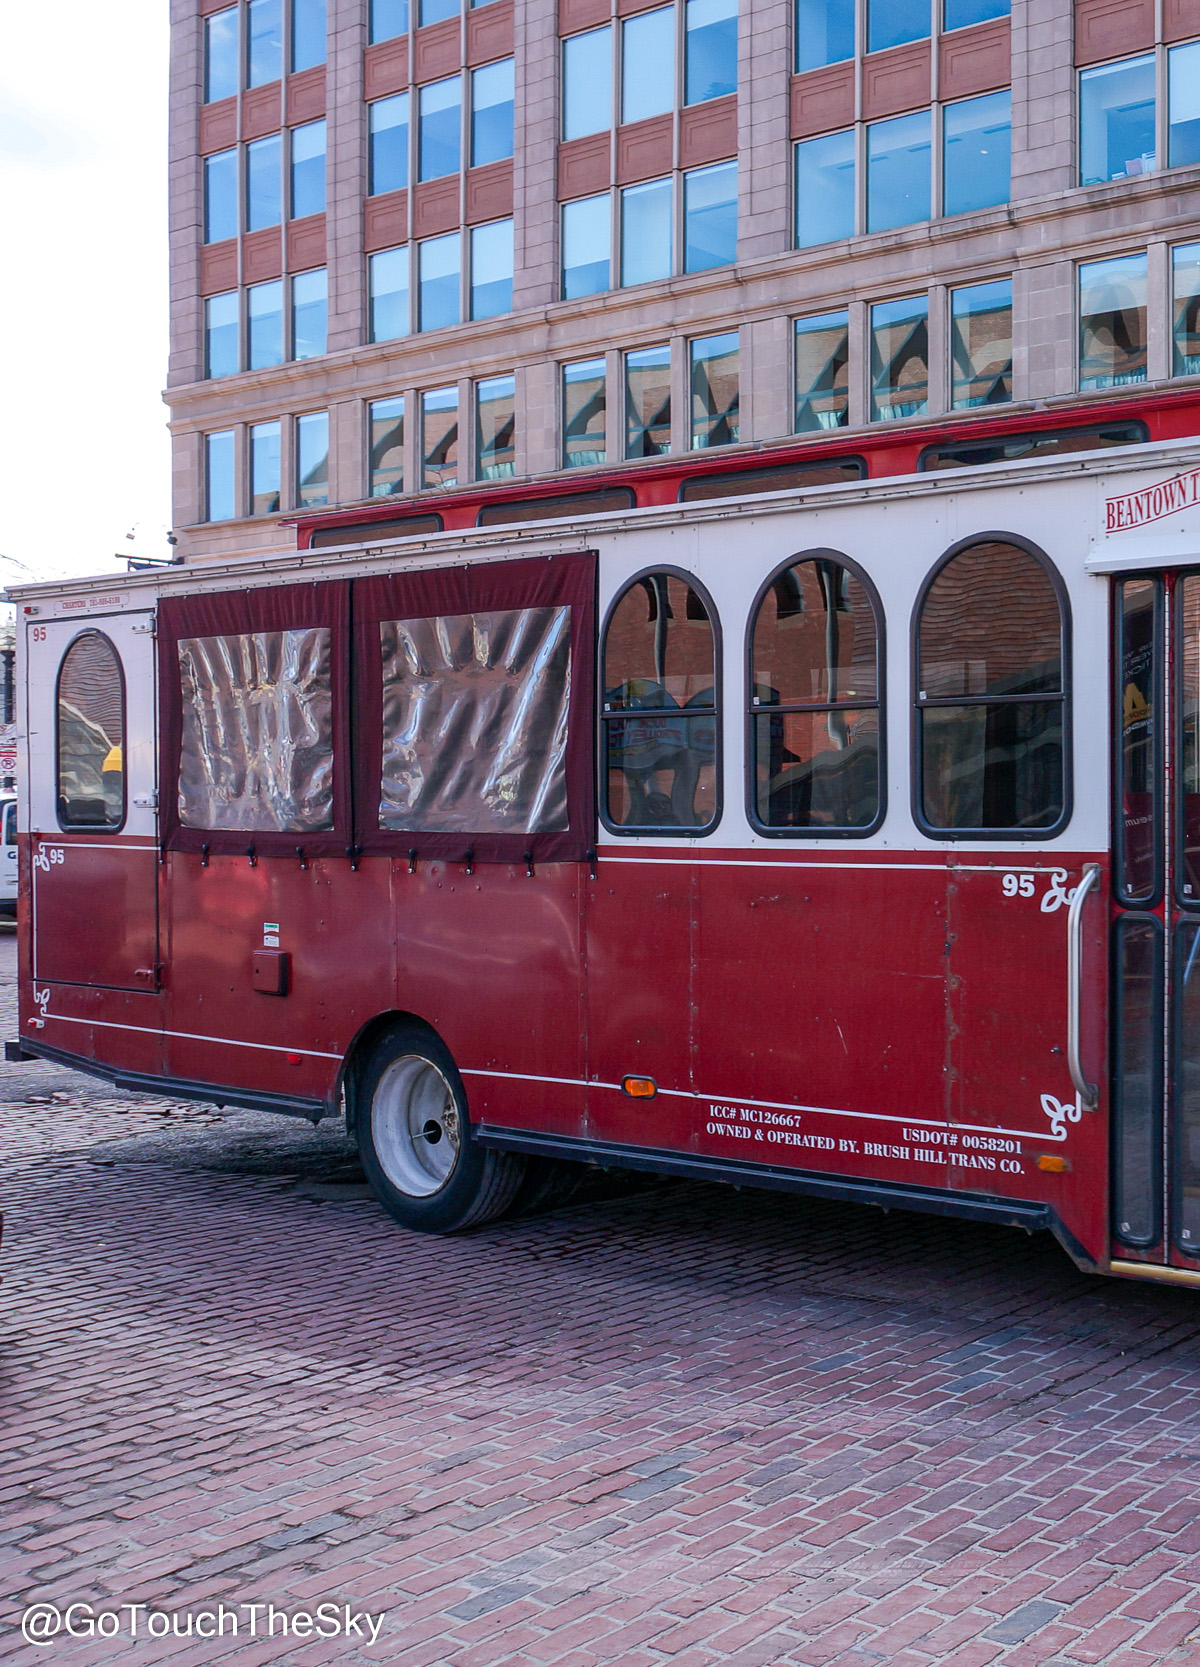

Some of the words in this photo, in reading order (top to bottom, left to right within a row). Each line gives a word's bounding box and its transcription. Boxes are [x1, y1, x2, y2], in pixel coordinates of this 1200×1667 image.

[1105, 475, 1188, 530] BEANTOWN
[32, 627, 47, 642] 95
[50, 849, 65, 864] 95
[1002, 873, 1036, 898] 95
[709, 1104, 737, 1121] ICC#
[739, 1108, 802, 1128] MC126667
[705, 1121, 751, 1140] OWNED
[754, 1130, 764, 1142] &
[766, 1130, 836, 1151] OPERATED
[863, 1142, 911, 1160] BRUSH
[913, 1147, 947, 1165] HILL
[948, 1152, 997, 1171] TRANS
[999, 1158, 1026, 1175] CO.
[902, 1127, 959, 1146] USDOT#
[961, 1133, 1022, 1155] 0058201
